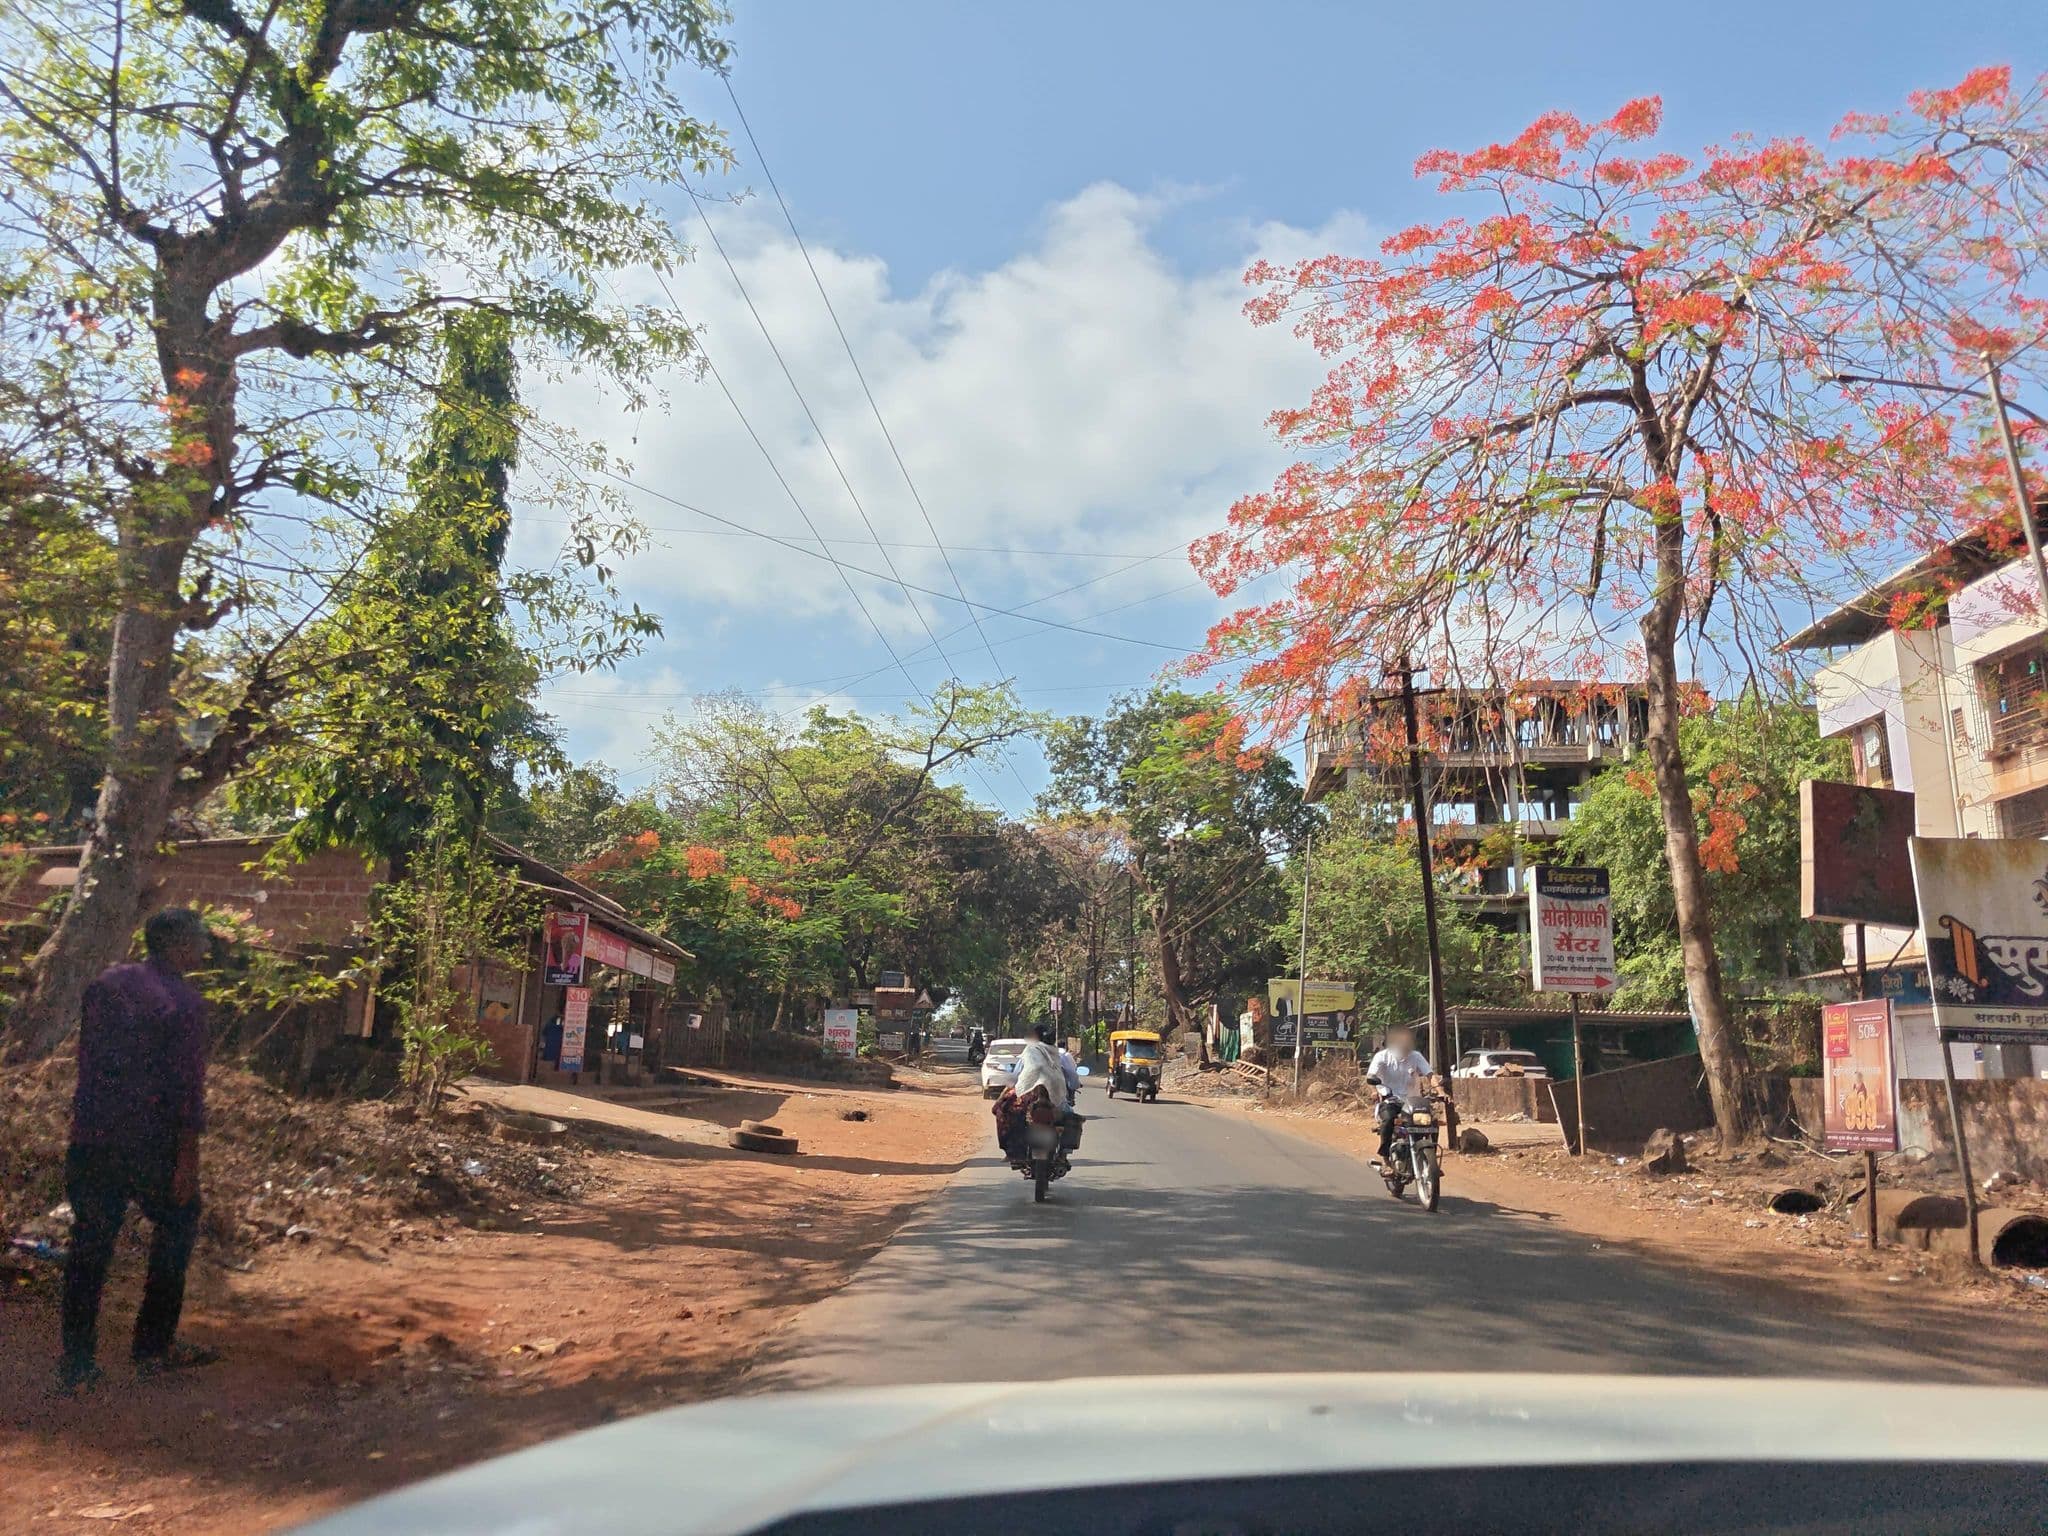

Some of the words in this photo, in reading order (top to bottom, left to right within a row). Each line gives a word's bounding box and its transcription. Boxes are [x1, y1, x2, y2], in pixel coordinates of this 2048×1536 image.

[1541, 902, 1607, 929] सोनोग्राफी
[1553, 932, 1600, 952] सेंटर
[1974, 1012, 2021, 1024] सहकारी
